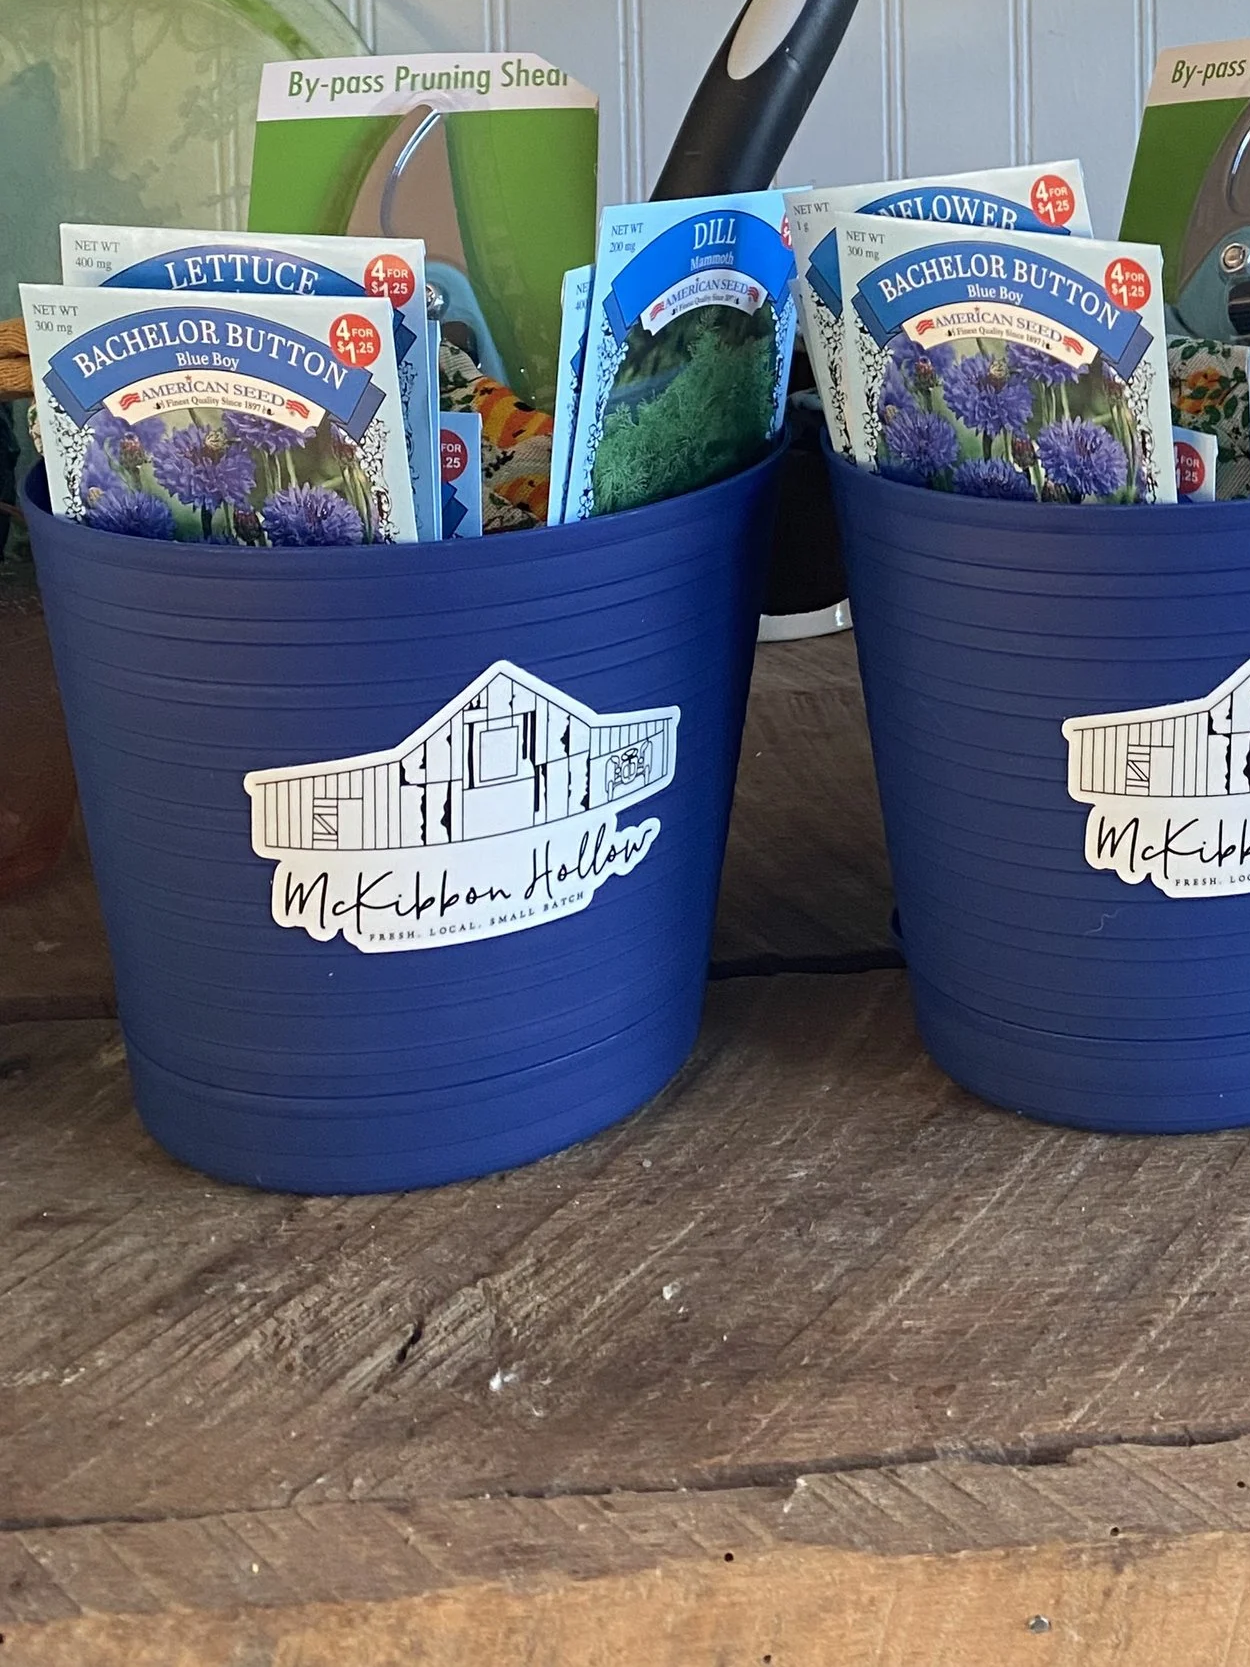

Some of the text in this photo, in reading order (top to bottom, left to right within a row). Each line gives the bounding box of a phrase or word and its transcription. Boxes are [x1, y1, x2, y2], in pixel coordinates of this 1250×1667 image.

[288, 71, 384, 102] By-pass
[394, 64, 490, 95] Pruning
[1171, 57, 1247, 89] By-pass
[1036, 180, 1068, 202] 4 FOR
[794, 202, 830, 215] NET WT
[877, 195, 1018, 230] NFLOWER
[1038, 200, 1069, 223] $1.25
[611, 223, 644, 236] NET WT
[693, 218, 737, 249] DILL
[846, 230, 885, 244] NET WT
[74, 240, 120, 253] NET WT
[609, 242, 623, 253] 200
[847, 246, 880, 261] 300 mg
[75, 257, 112, 271] 400 mg
[371, 259, 408, 281] 4 FOR
[690, 251, 734, 271] Mammoth
[164, 254, 319, 296] LETTUCE
[1110, 262, 1145, 284] 4 FOR
[371, 281, 408, 298] $1.25
[665, 278, 720, 308] AMERICAN
[720, 279, 748, 295] SEED
[877, 254, 1120, 330] BACHELOR BUTTON
[967, 283, 1024, 305] Blue Boy
[1111, 283, 1145, 306] $1.25
[33, 304, 79, 317] NET WT
[35, 321, 73, 335] 300 mg
[335, 319, 373, 341] 4 FOR
[934, 311, 1062, 342] AMERICAN SEED
[72, 319, 348, 390] BACHELOR BUTTON
[175, 351, 239, 371] Blue Boy
[337, 341, 374, 363] $1.25
[140, 378, 285, 407] AMERICAN SEED
[441, 443, 462, 453] FOR
[443, 456, 461, 468] .25
[1180, 455, 1200, 468] FOR
[285, 822, 653, 935] McKibbon Hollow
[489, 908, 534, 926] SMALL
[543, 890, 585, 913] BATCH
